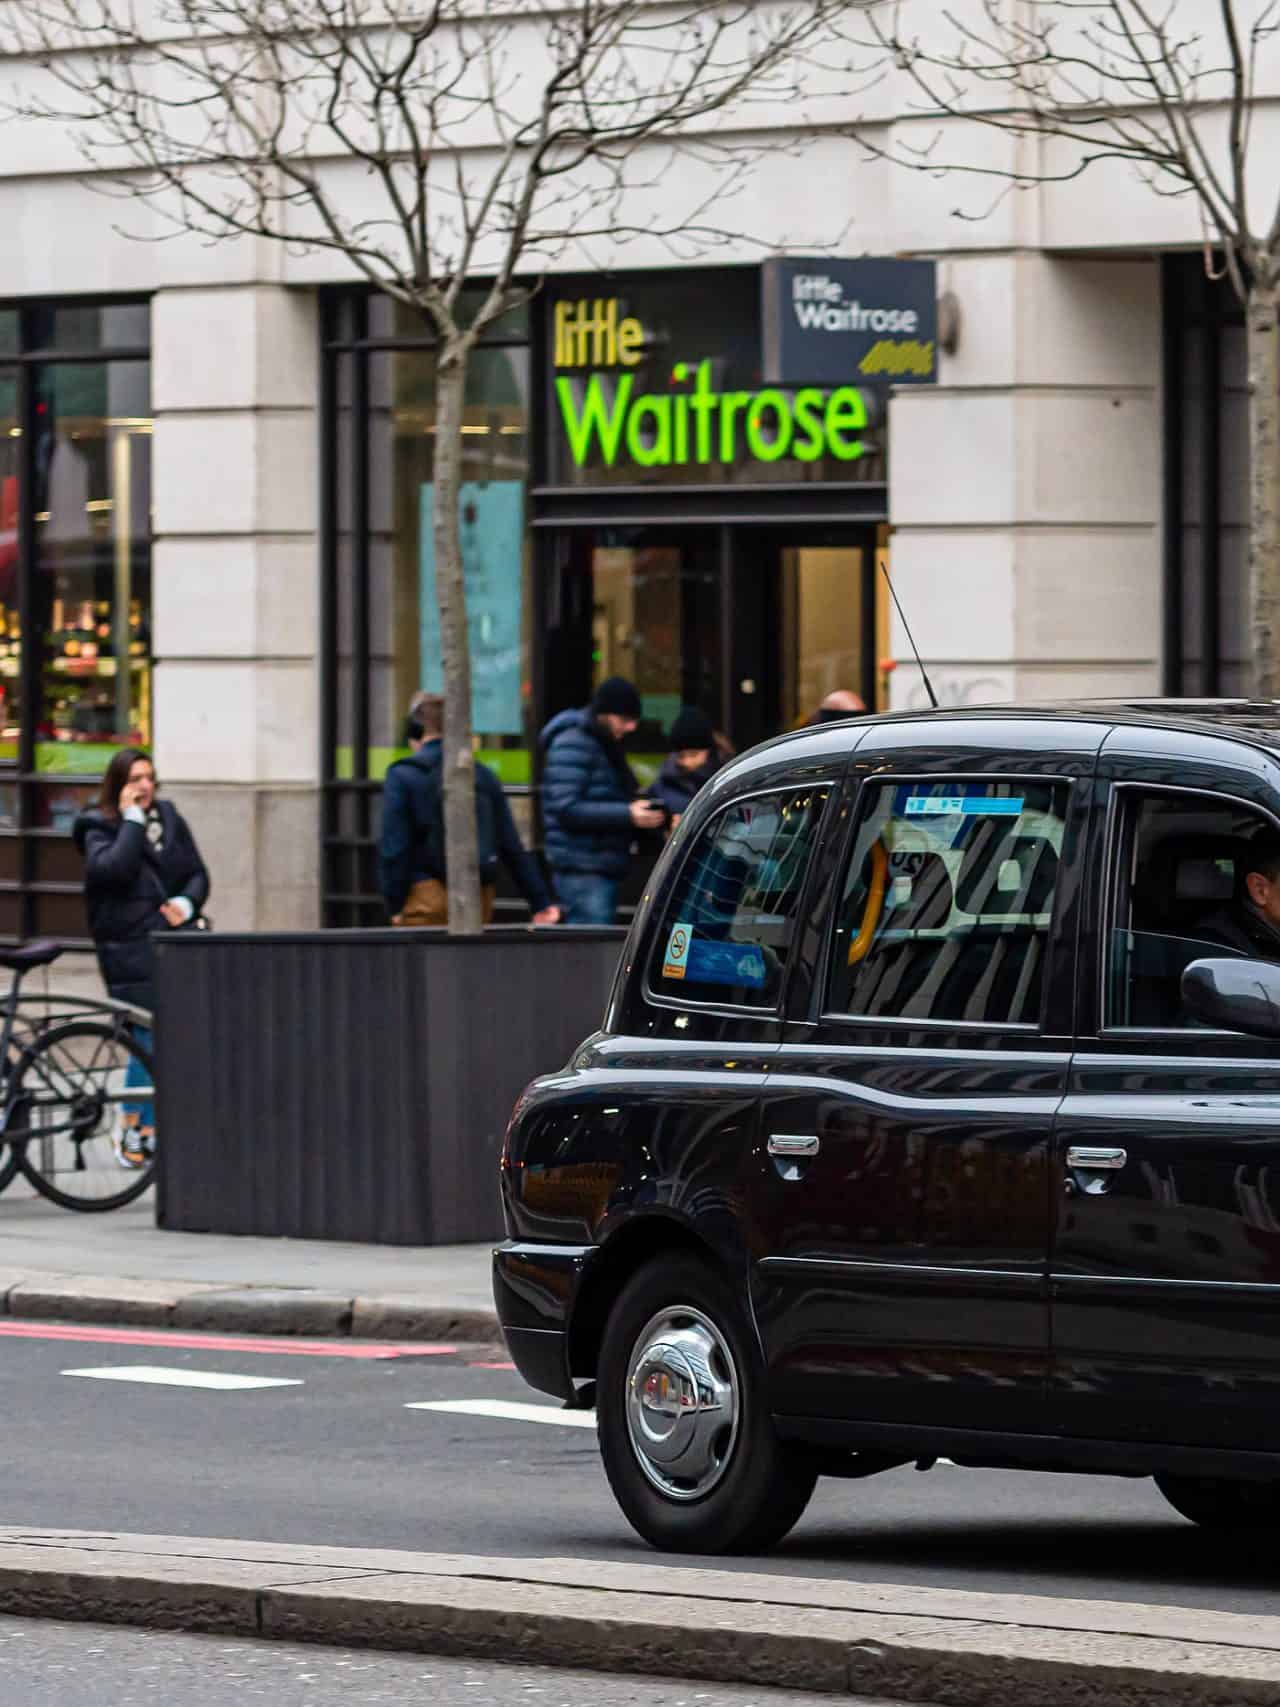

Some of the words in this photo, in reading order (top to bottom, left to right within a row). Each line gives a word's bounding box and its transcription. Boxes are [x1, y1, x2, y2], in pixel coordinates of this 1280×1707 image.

[793, 274, 843, 302] little
[554, 298, 644, 367] little
[793, 300, 919, 333] Waitrose
[554, 357, 868, 466] Waitrose
